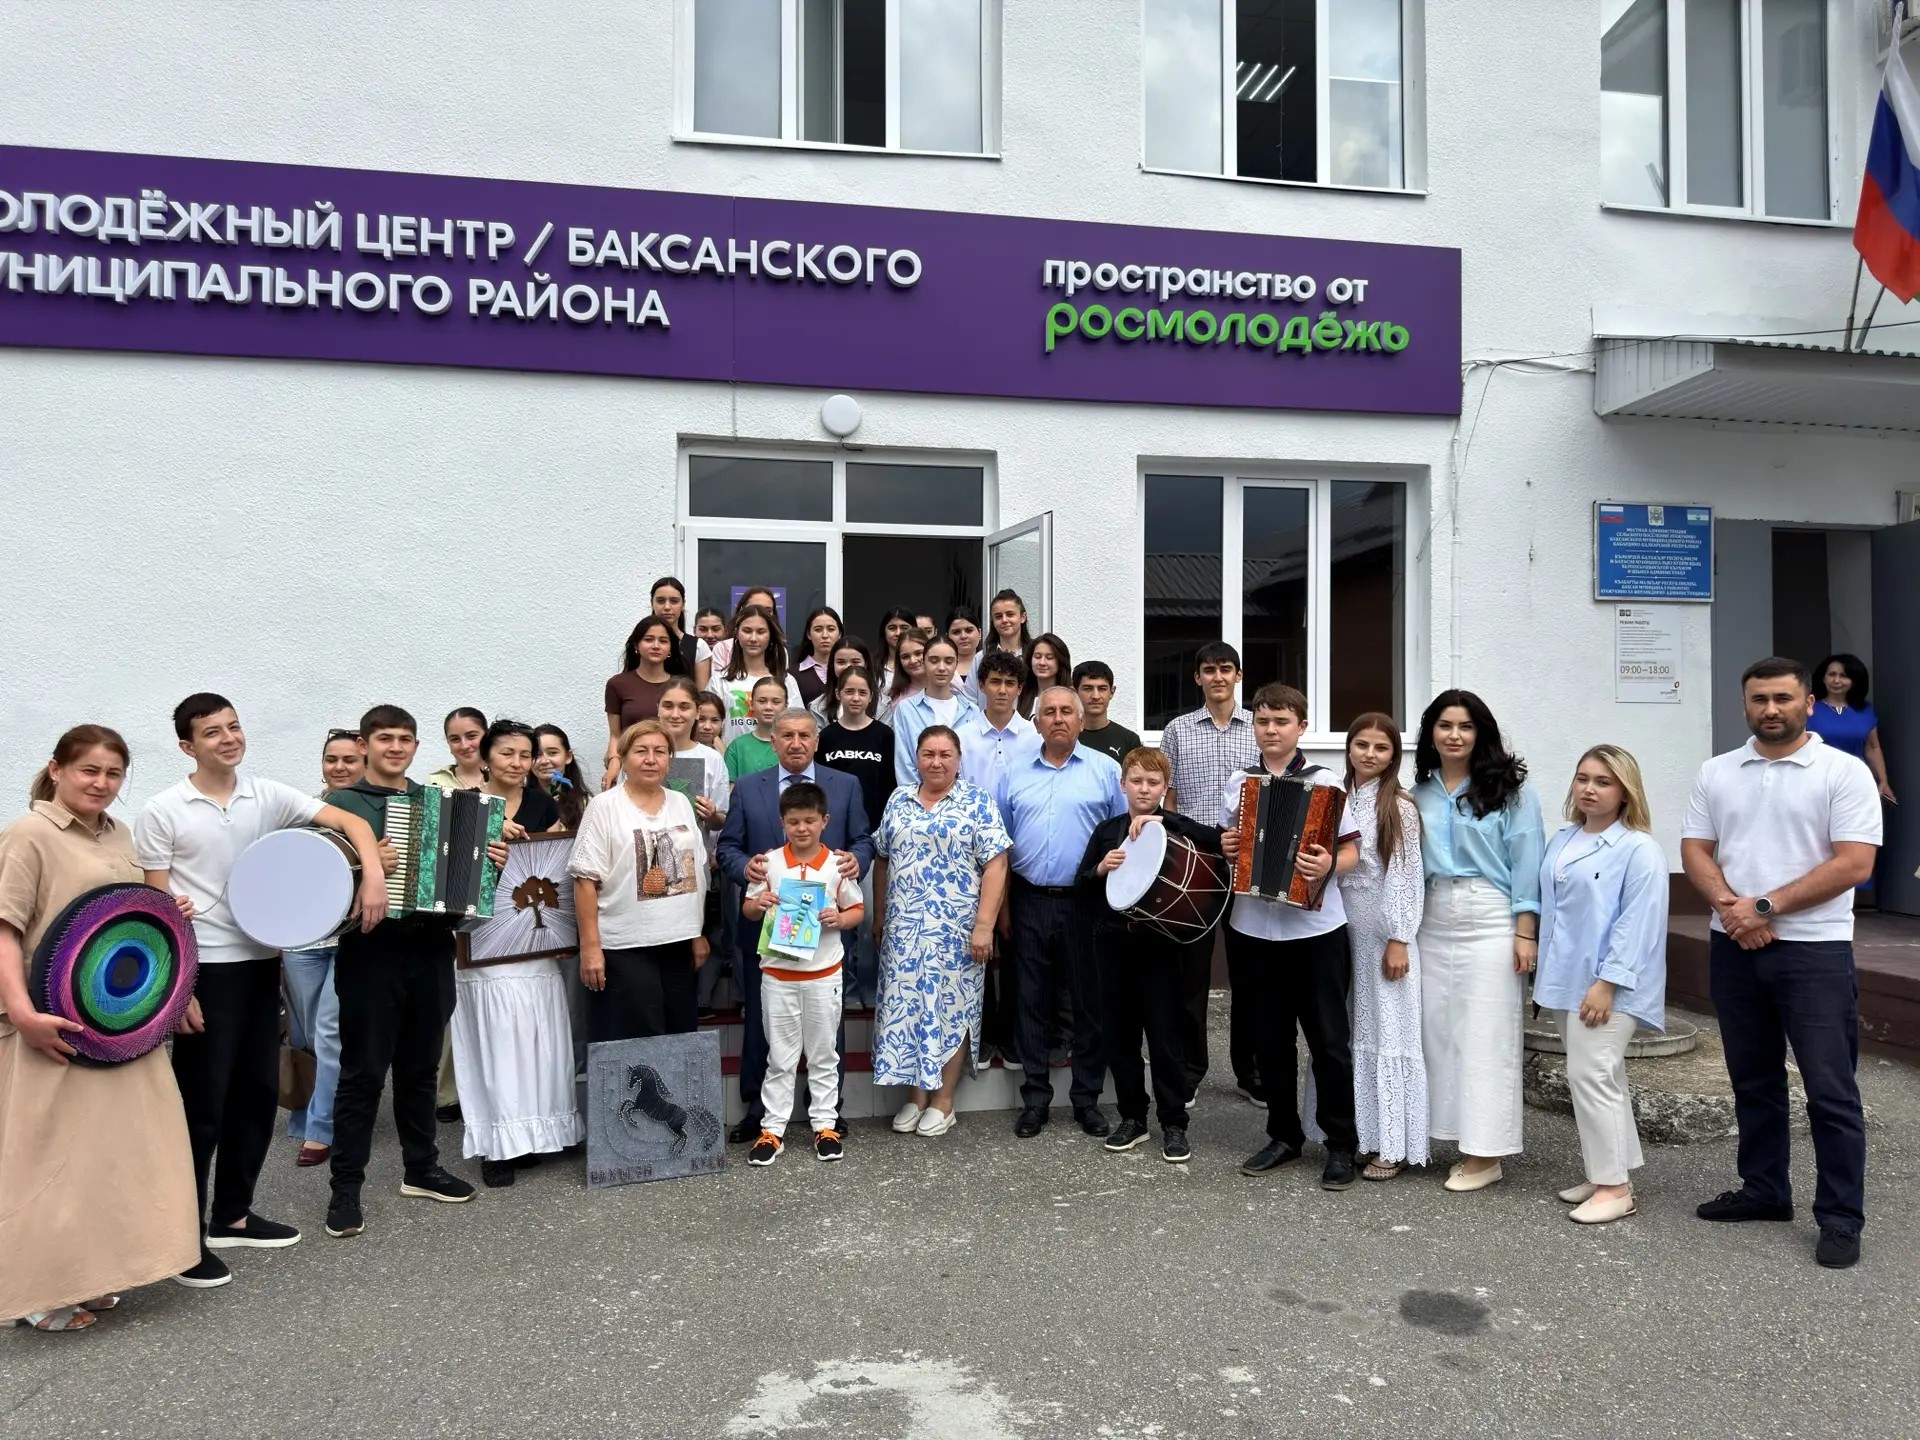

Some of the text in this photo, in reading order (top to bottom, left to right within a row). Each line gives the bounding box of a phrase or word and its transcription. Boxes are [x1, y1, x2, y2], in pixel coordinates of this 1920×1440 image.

[356, 213, 515, 260] ЦЕНТР
[568, 227, 922, 288] БАКСАНСКОГО
[0, 252, 671, 330] НИЦИПАЛЬНОГО РАЙОНА
[1043, 258, 1369, 304] пространство от
[1045, 302, 1411, 354] росмолодёжь
[730, 718, 744, 727] BIG
[825, 750, 883, 762] КАВКАЗ
